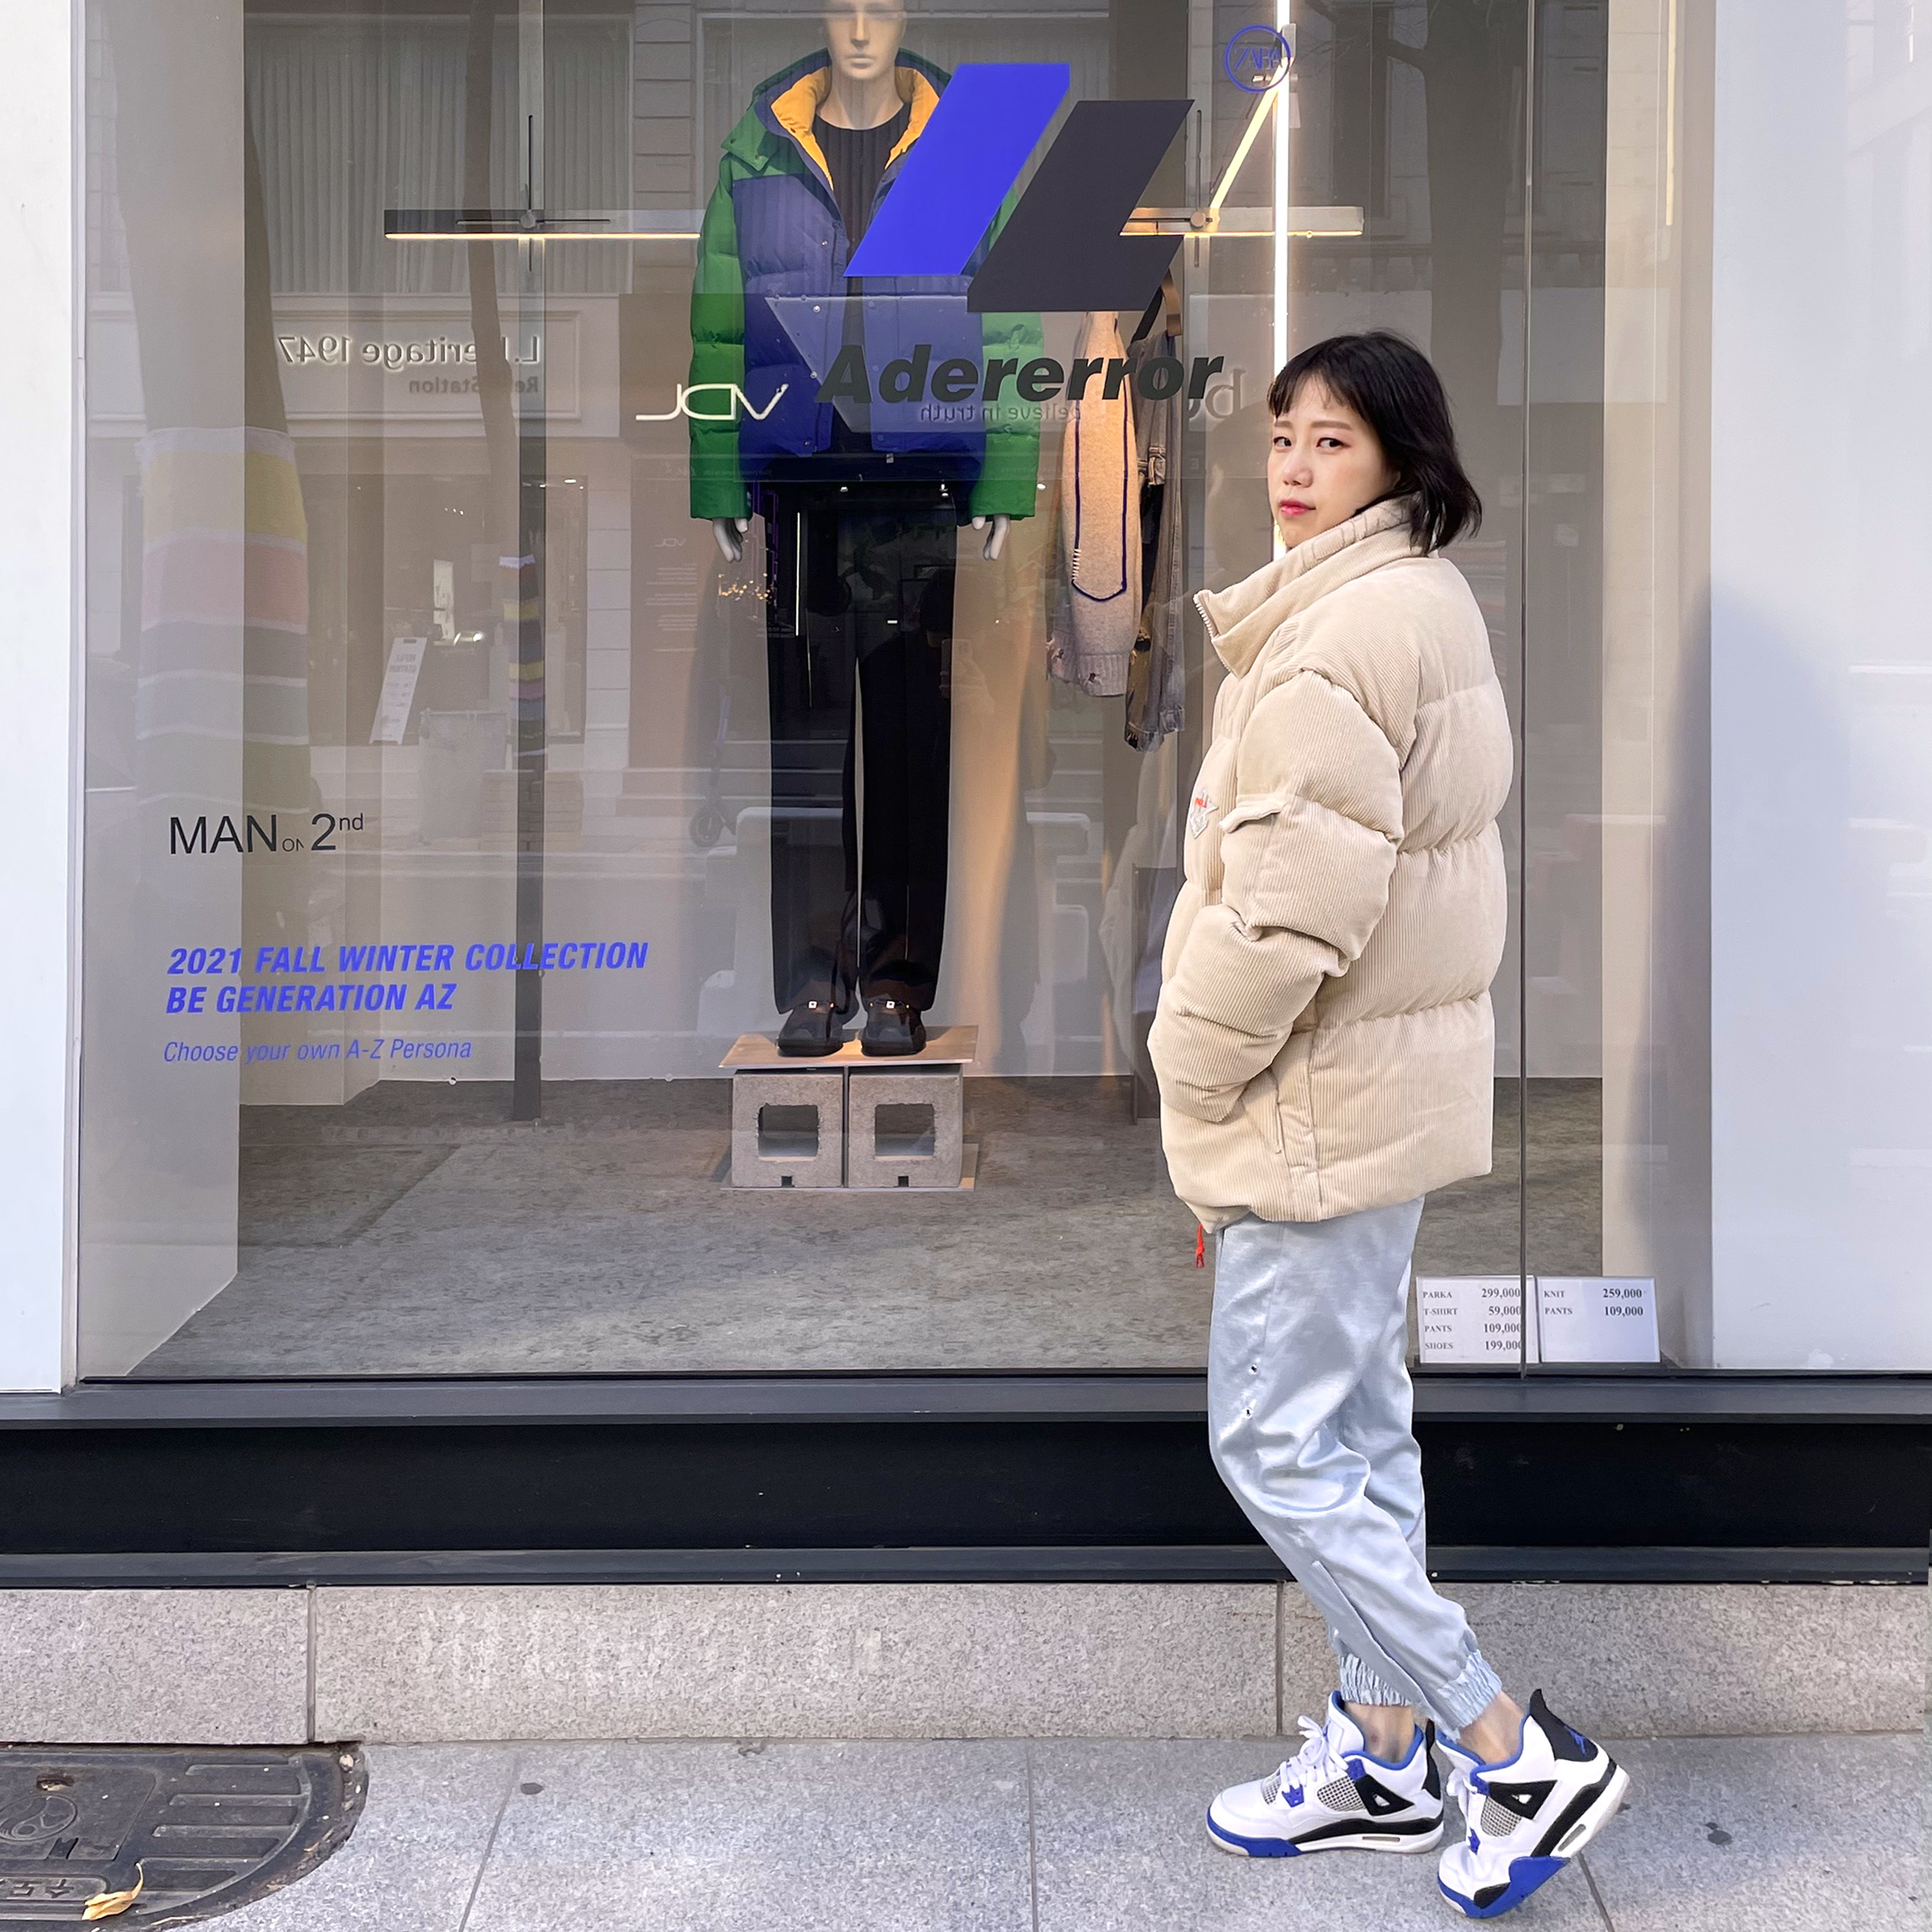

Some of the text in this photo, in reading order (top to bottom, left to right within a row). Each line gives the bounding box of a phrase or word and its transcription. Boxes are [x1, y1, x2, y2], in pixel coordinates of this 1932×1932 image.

[815, 344, 1225, 404] Adererror
[170, 815, 276, 854] MAN
[311, 813, 363, 851] 2nd
[167, 942, 649, 975] 2021 FALL WINTER COLLECTION
[166, 982, 458, 1014] BE GENERATION AZ
[164, 1039, 472, 1065] Choose your own A-Z Persona
[1481, 1288, 1522, 1298] 299,000
[1544, 1288, 1643, 1299] KNIT 259,000
[1423, 1305, 1522, 1317] T-SHIRT 59,000
[1544, 1306, 1643, 1317] PANTS 109,000
[1425, 1342, 1454, 1350] SHOES
